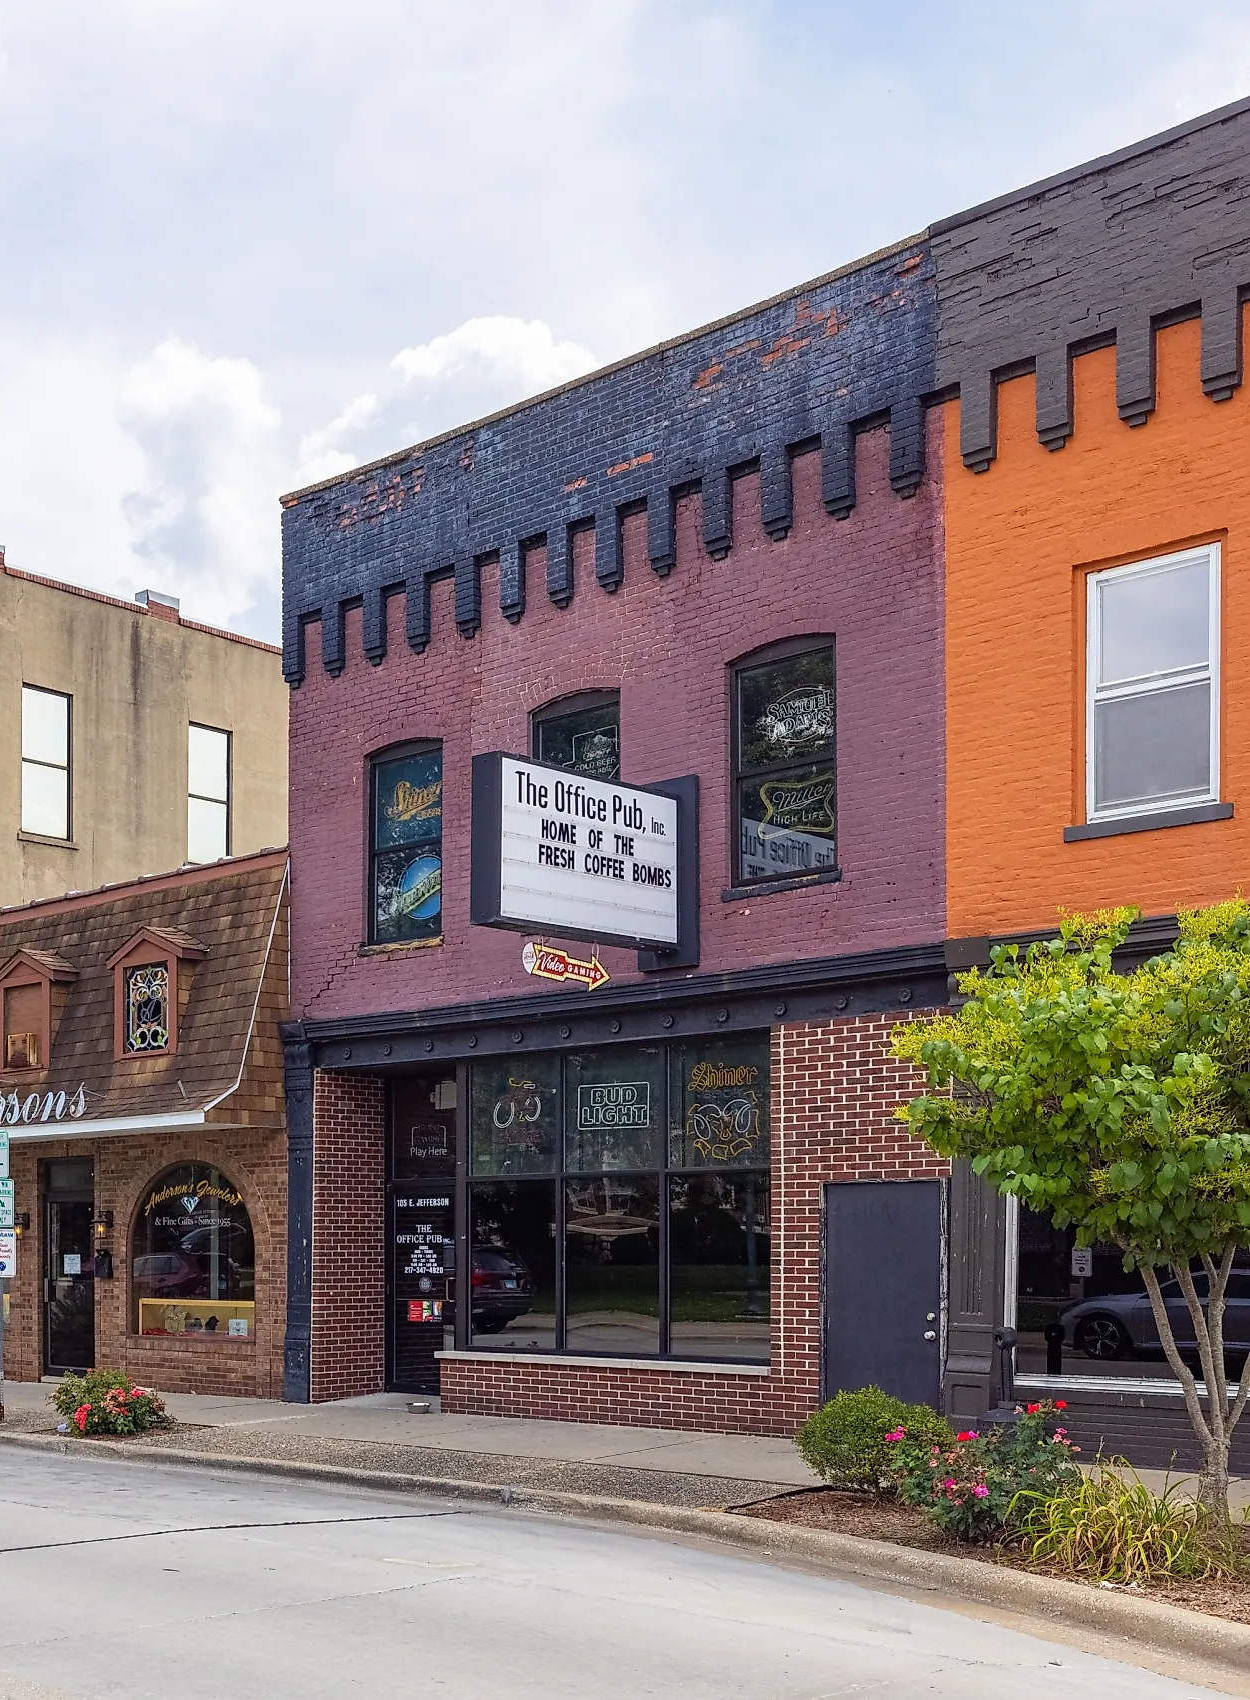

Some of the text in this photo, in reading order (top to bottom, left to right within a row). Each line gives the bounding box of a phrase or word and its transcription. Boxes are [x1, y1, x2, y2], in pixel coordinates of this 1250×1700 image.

[767, 690, 834, 723] SAMUEL
[514, 770, 667, 837] The Office Pub, Inc.
[772, 783, 832, 810] Miller
[773, 809, 825, 825] HIGH LIFE
[540, 818, 635, 857] HOME OF THE
[538, 843, 672, 888] FRESH COFFEE BOMBS
[538, 952, 565, 973] Video
[567, 964, 602, 980] GAMING
[688, 1062, 759, 1091] Shiner
[590, 1086, 638, 1107] BUD
[581, 1104, 648, 1126] LIGHT
[410, 1146, 448, 1160] Play Here
[144, 1180, 241, 1217] Anderson's Jewelers
[396, 1197, 450, 1208] 105 E. JEFFERSON
[154, 1217, 162, 1226] &
[162, 1216, 177, 1226] Fine
[177, 1216, 194, 1226] Gifts
[198, 1216, 217, 1226] Since
[415, 1224, 432, 1233] THE
[396, 1234, 425, 1244] OFFICE
[426, 1234, 443, 1243] PUB
[404, 1266, 444, 1274] 217-347-4920
